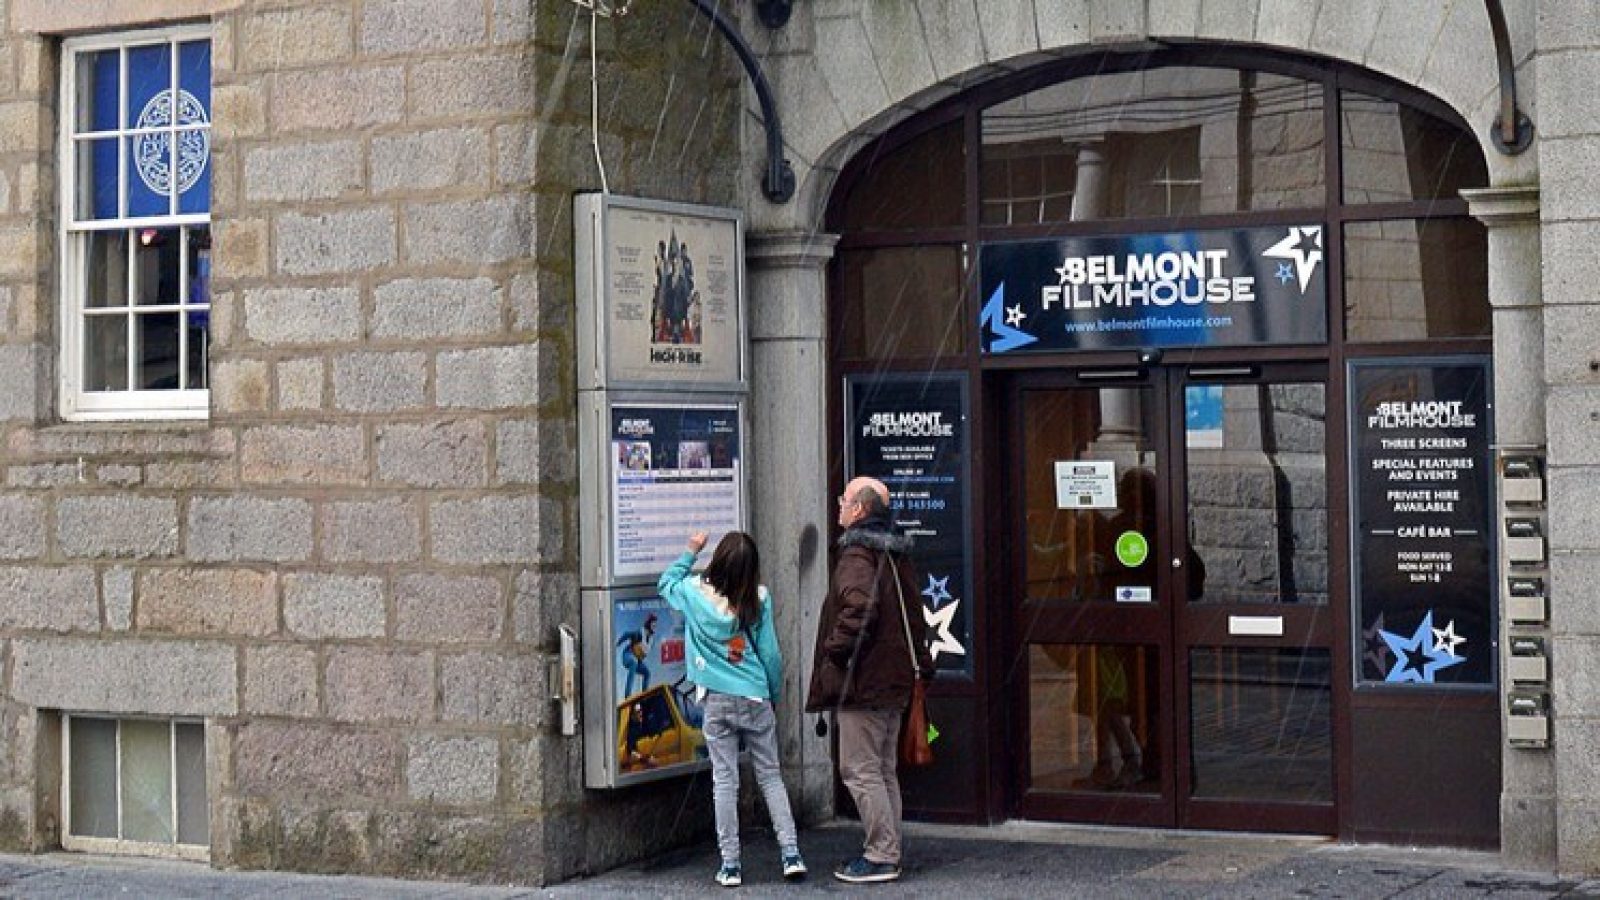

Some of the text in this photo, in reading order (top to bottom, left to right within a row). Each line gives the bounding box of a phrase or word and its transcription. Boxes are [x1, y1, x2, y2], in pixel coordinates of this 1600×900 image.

[1060, 249, 1228, 285] BELMONT
[1042, 277, 1255, 310] FILMHOUSE
[1064, 316, 1232, 332] www.belmontfilmhouse.com
[1378, 401, 1462, 415] BELMONT
[871, 411, 942, 425] BELMONT
[1368, 414, 1476, 428] FILMHOUSE
[863, 423, 954, 437] FILMHOUSE
[1381, 437, 1468, 449] THREE SCREENS
[1372, 457, 1474, 469] SPECIAL FEATURES
[1388, 469, 1458, 480] AND EVENTS
[1387, 489, 1460, 501] PRIVATE HIRE
[1393, 501, 1453, 513] AVAILABLE
[1398, 523, 1452, 538] CAFÉ BAR
